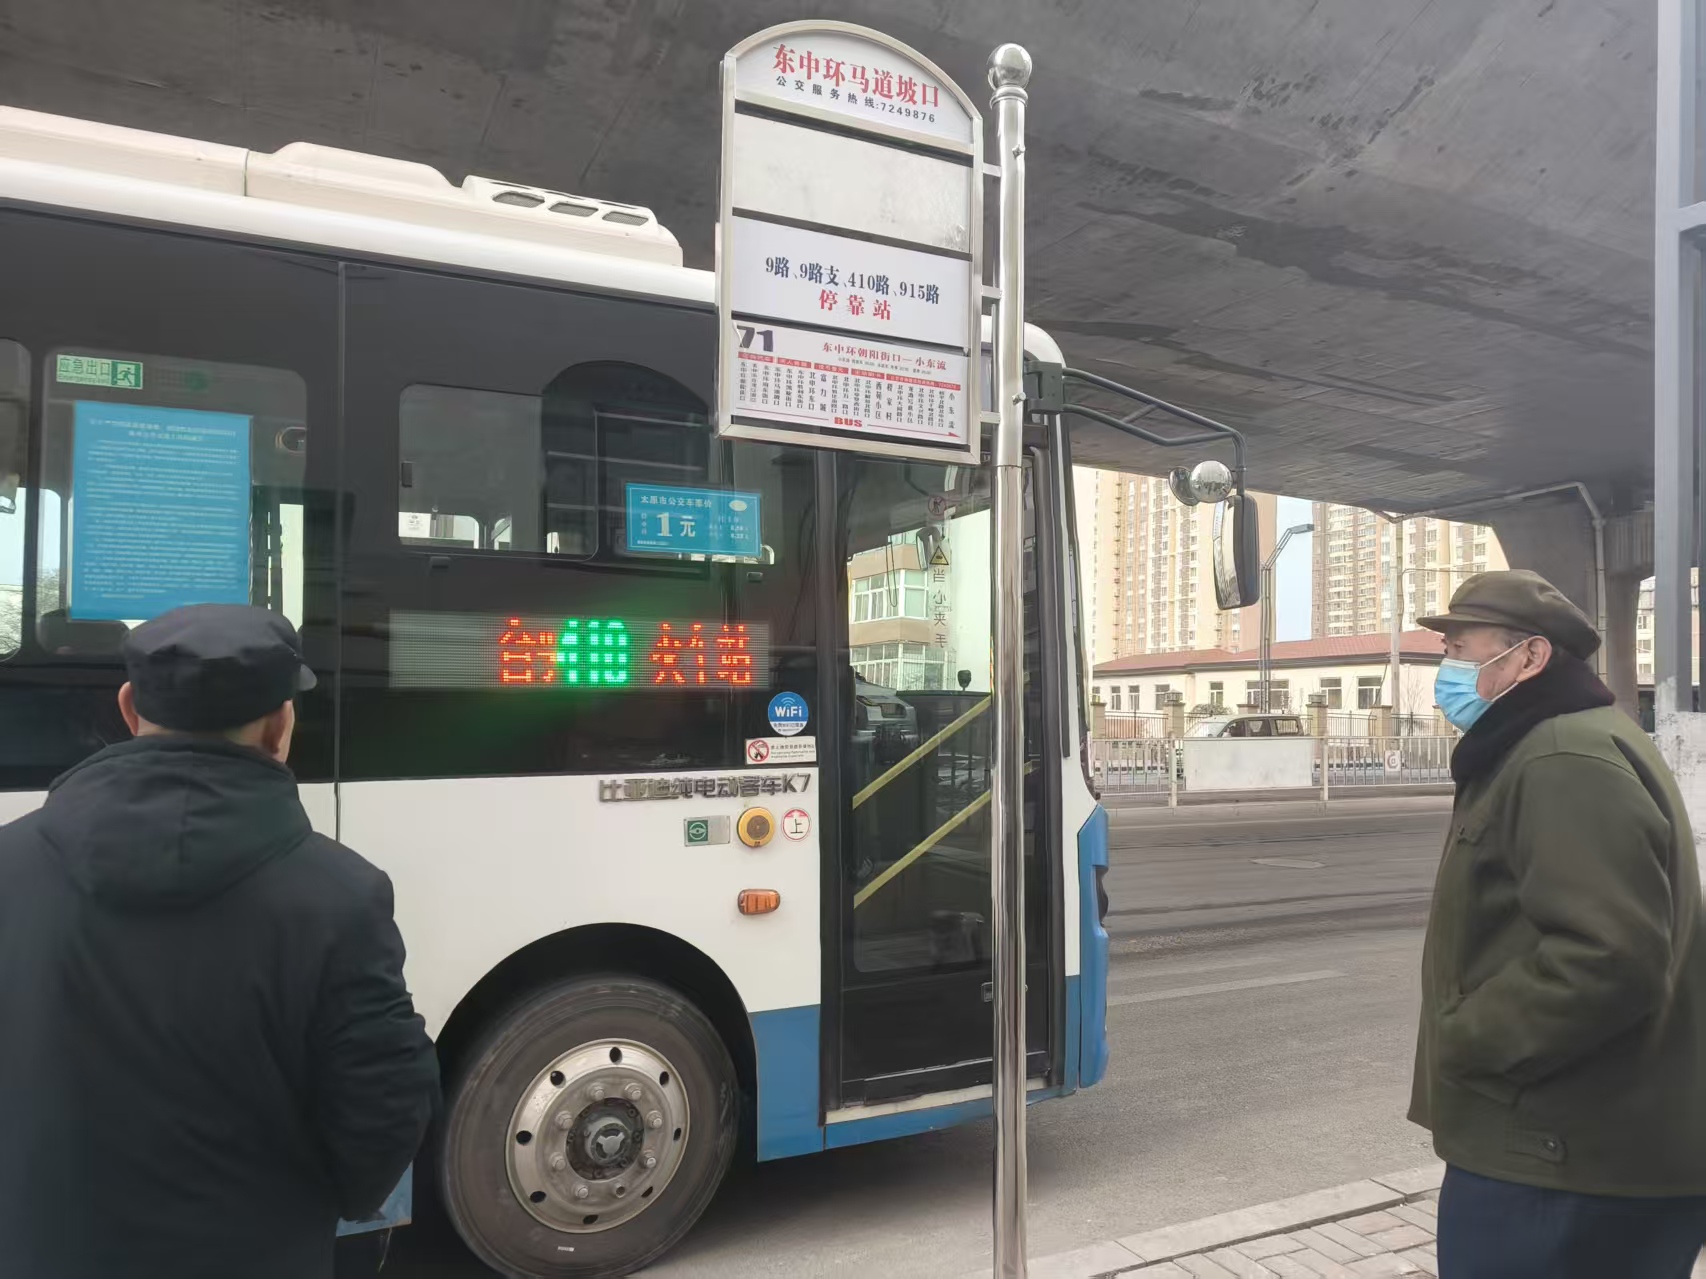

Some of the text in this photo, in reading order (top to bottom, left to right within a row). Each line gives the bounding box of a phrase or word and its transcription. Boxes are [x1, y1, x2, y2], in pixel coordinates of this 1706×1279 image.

[773, 43, 939, 107] 东中环马道坡口
[776, 75, 935, 122] 公交服务热线:7249876
[765, 256, 940, 304] 9路、9路支、410路、915路
[819, 288, 891, 320] 停靠站
[737, 325, 774, 352] 71
[59, 357, 110, 375] 应急出口
[808, 372, 816, 411] 北中环东口
[819, 373, 827, 412] 富力城
[834, 417, 863, 427] BUS
[641, 495, 712, 508] 太原市公交车票价
[774, 706, 802, 718] WiFi
[599, 773, 811, 802] 比亚迪纯电动客车K7
[790, 818, 803, 833] 上
